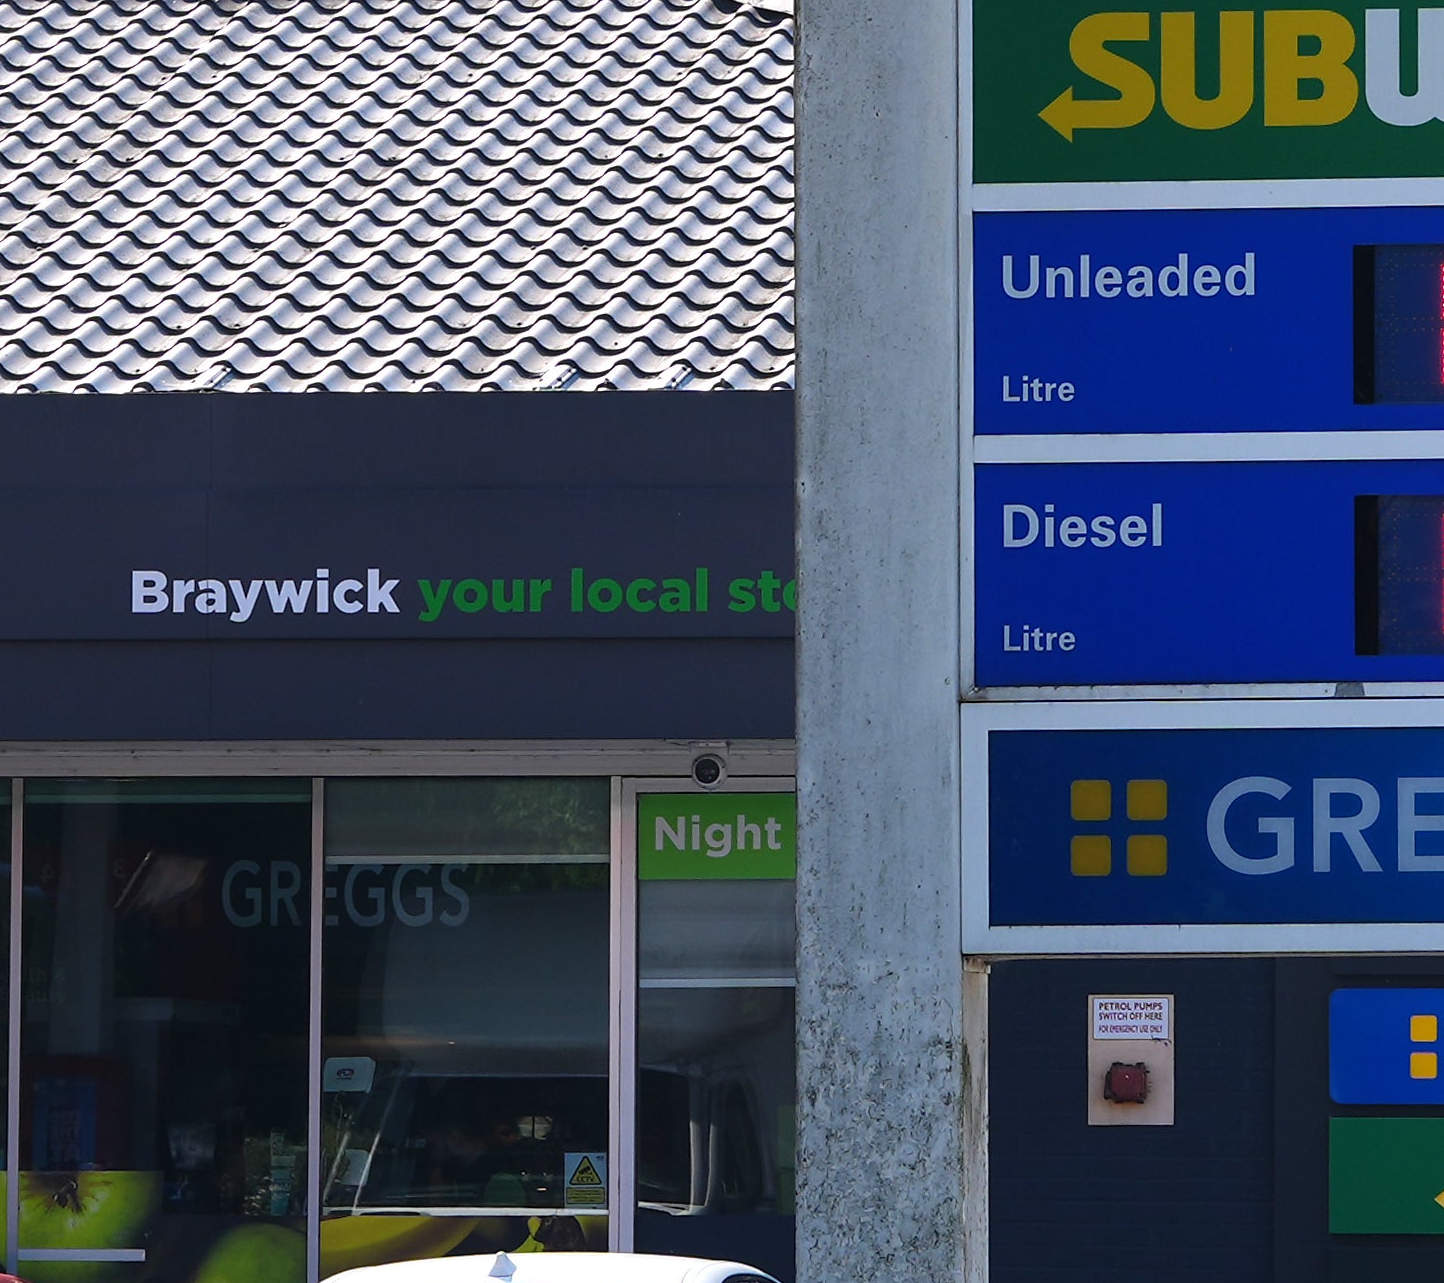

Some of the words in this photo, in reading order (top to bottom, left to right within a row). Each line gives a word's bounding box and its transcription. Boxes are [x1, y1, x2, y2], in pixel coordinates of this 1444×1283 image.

[1001, 253, 1257, 300] Unleaded
[1001, 375, 1075, 404] Litre
[1001, 504, 1163, 550] Diesel
[130, 568, 400, 622] Braywick
[417, 575, 552, 621] your
[569, 568, 708, 614] local
[1001, 624, 1076, 653] Litre
[654, 816, 782, 858] Night
[1099, 1002, 1132, 1010] PETROL
[1134, 1002, 1163, 1010] PUMPS
[1099, 1012, 1128, 1020] SWITCH
[1129, 1012, 1143, 1020] OFF
[1145, 1012, 1163, 1020] HERE
